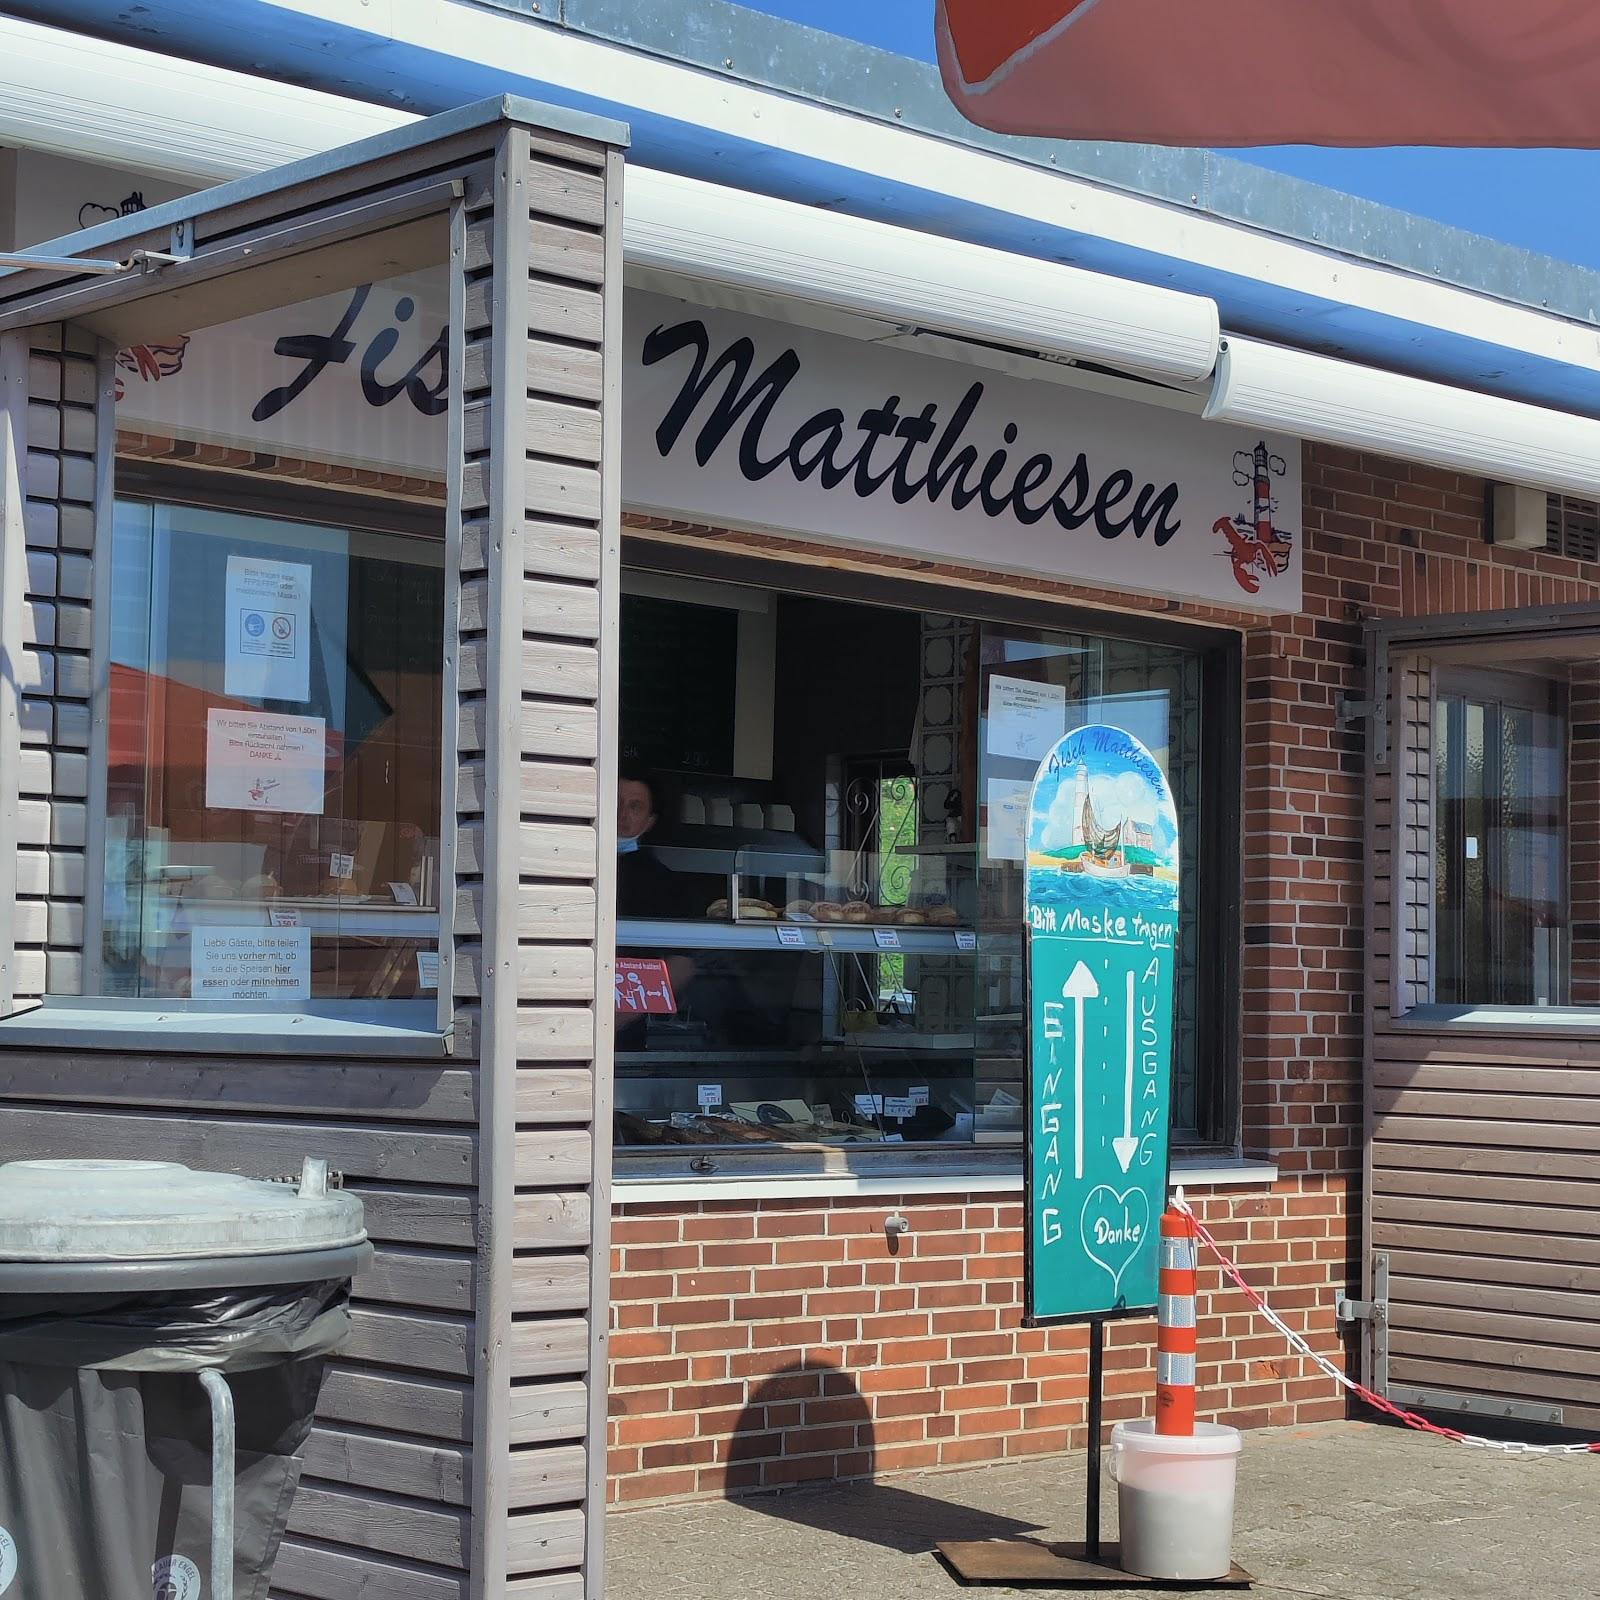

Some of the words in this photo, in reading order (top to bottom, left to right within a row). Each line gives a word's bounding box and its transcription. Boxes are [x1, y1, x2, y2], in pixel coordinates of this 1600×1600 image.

[641, 319, 1181, 546] Matthiesen
[249, 751, 273, 760] DANKE
[1049, 734, 1087, 783] Fisch
[1093, 729, 1166, 797] Matthiesen
[1061, 906, 1128, 940] Maske
[203, 938, 226, 948] Liebe
[257, 938, 275, 948] bitte
[277, 938, 299, 948] teilen
[206, 951, 219, 960] Sie
[221, 952, 236, 960] uns
[238, 951, 266, 961] vorher
[285, 951, 297, 960] ob
[202, 978, 229, 987] essen
[230, 977, 249, 986] oder
[250, 977, 300, 987] mitnehmen
[211, 964, 223, 973] sie
[225, 963, 238, 973] die
[240, 963, 272, 975] Speisen
[274, 963, 291, 974] hier
[1139, 956, 1160, 1167] AUSGANG
[1041, 1000, 1065, 1246] EINGANG
[1094, 1206, 1142, 1246] Danke
[178, 1560, 196, 1582] ENGEL
